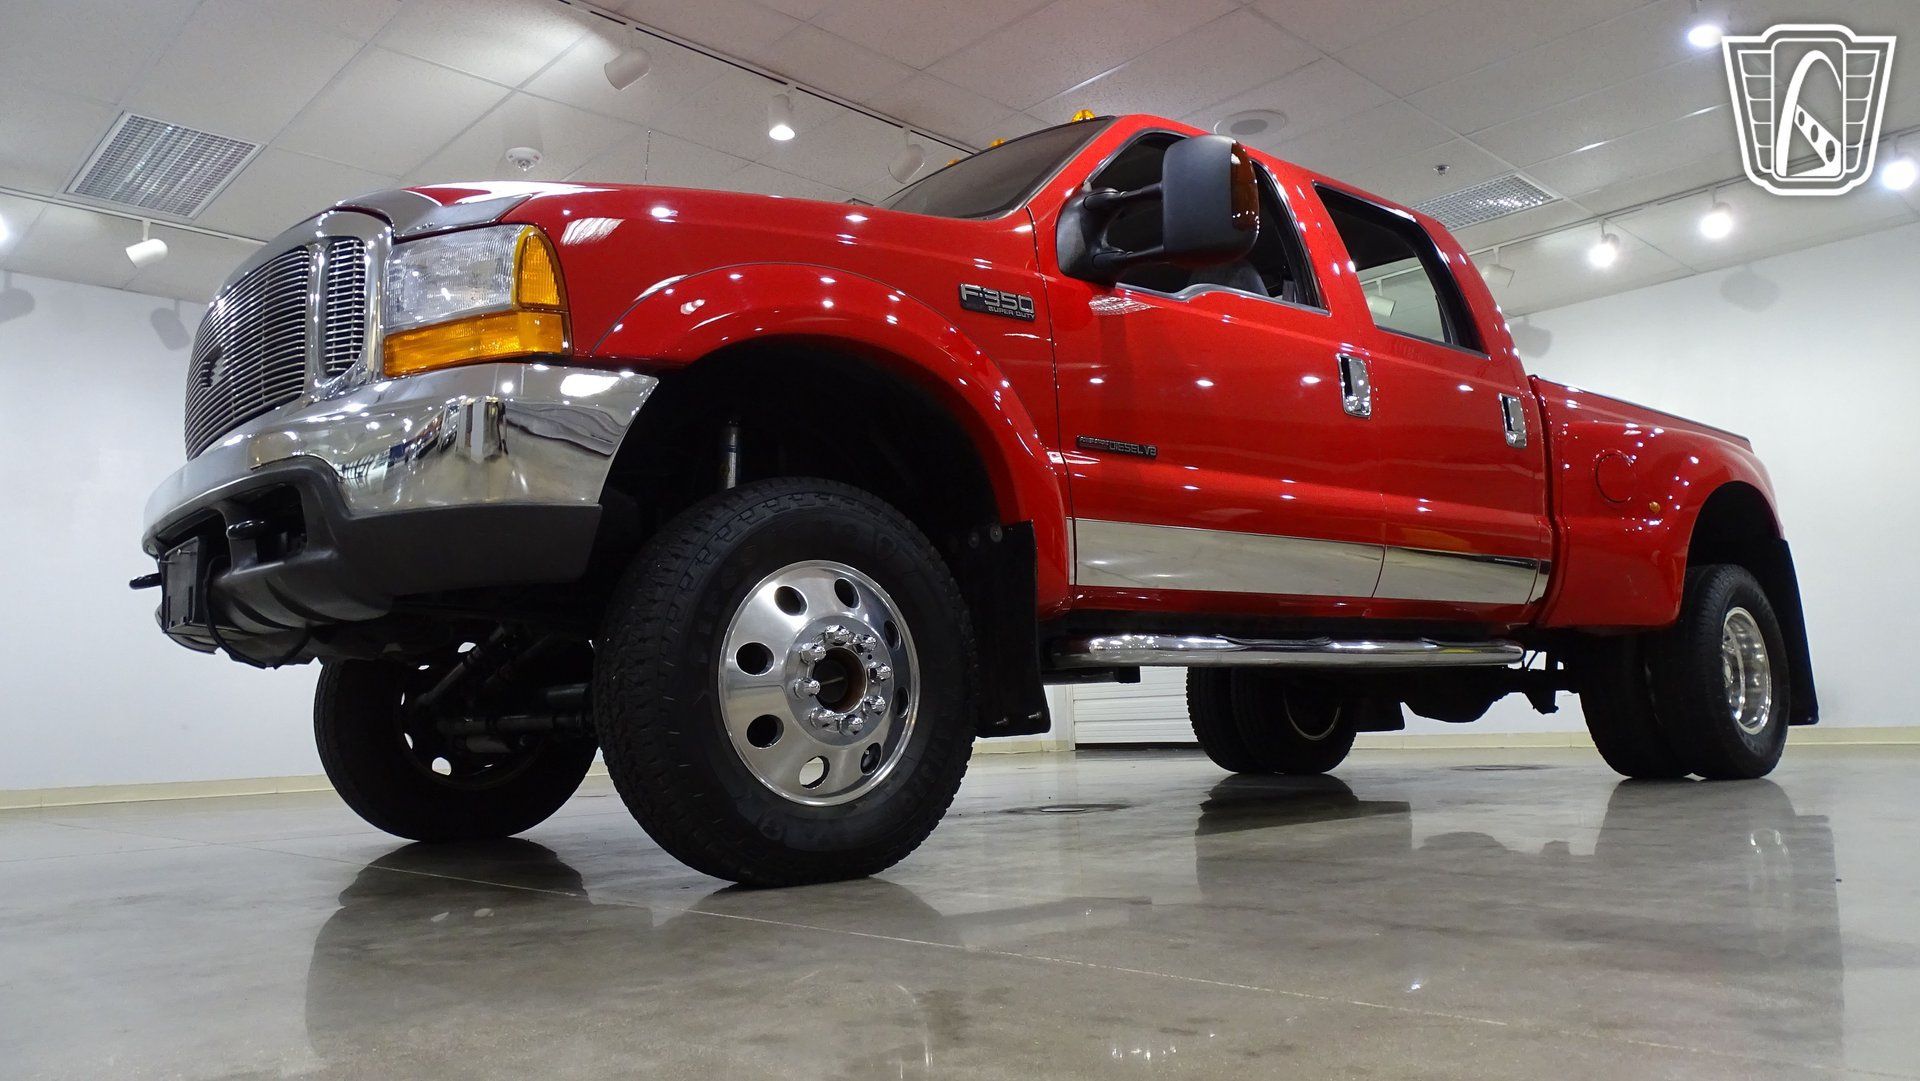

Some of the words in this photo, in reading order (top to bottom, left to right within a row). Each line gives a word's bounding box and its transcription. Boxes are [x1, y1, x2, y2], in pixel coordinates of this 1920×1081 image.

[988, 306, 1014, 315] SUPER
[1015, 311, 1035, 319] DUTY
[1109, 441, 1143, 454] DIESEL
